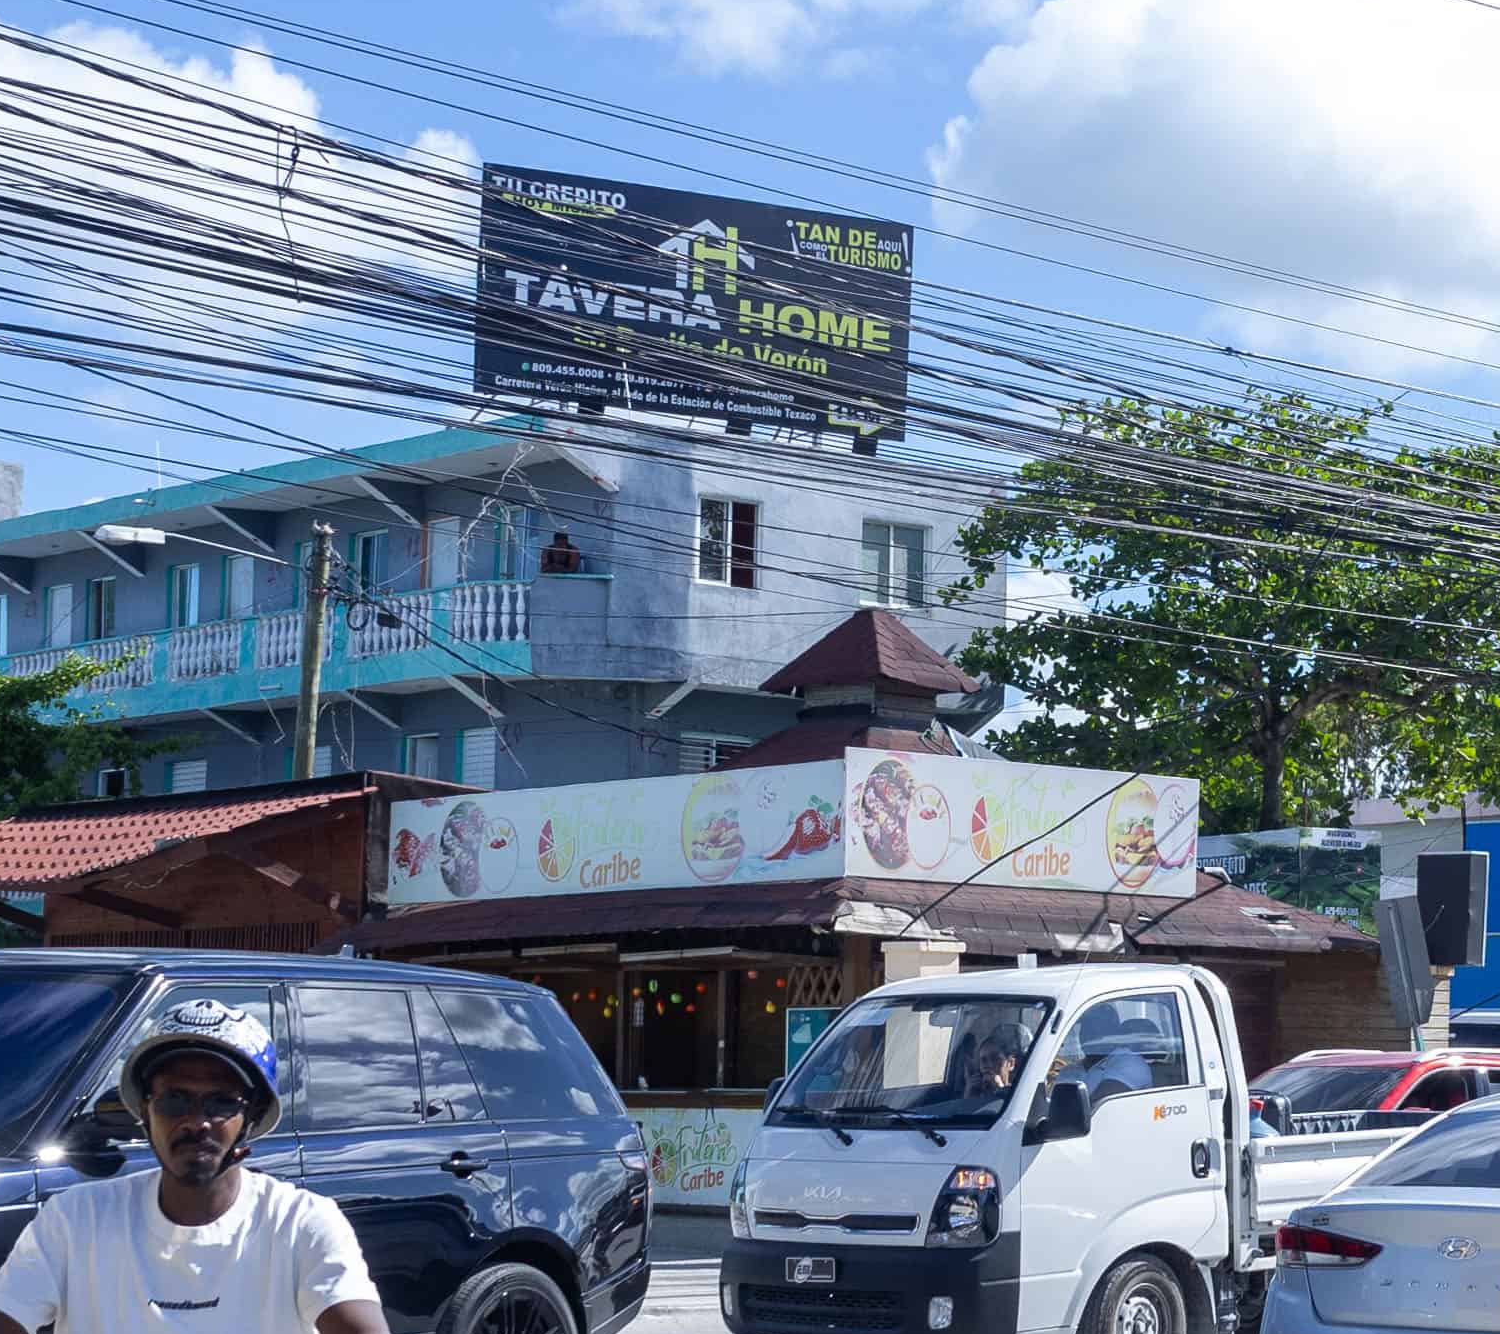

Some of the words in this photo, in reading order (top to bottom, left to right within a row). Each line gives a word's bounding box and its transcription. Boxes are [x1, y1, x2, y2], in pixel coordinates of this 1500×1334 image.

[849, 229, 876, 249] DE
[505, 270, 721, 331] TAVERA
[739, 299, 891, 352] HOME
[580, 851, 641, 888] Caribe
[1012, 847, 1070, 877] Caribe
[680, 1170, 724, 1192] Caribe
